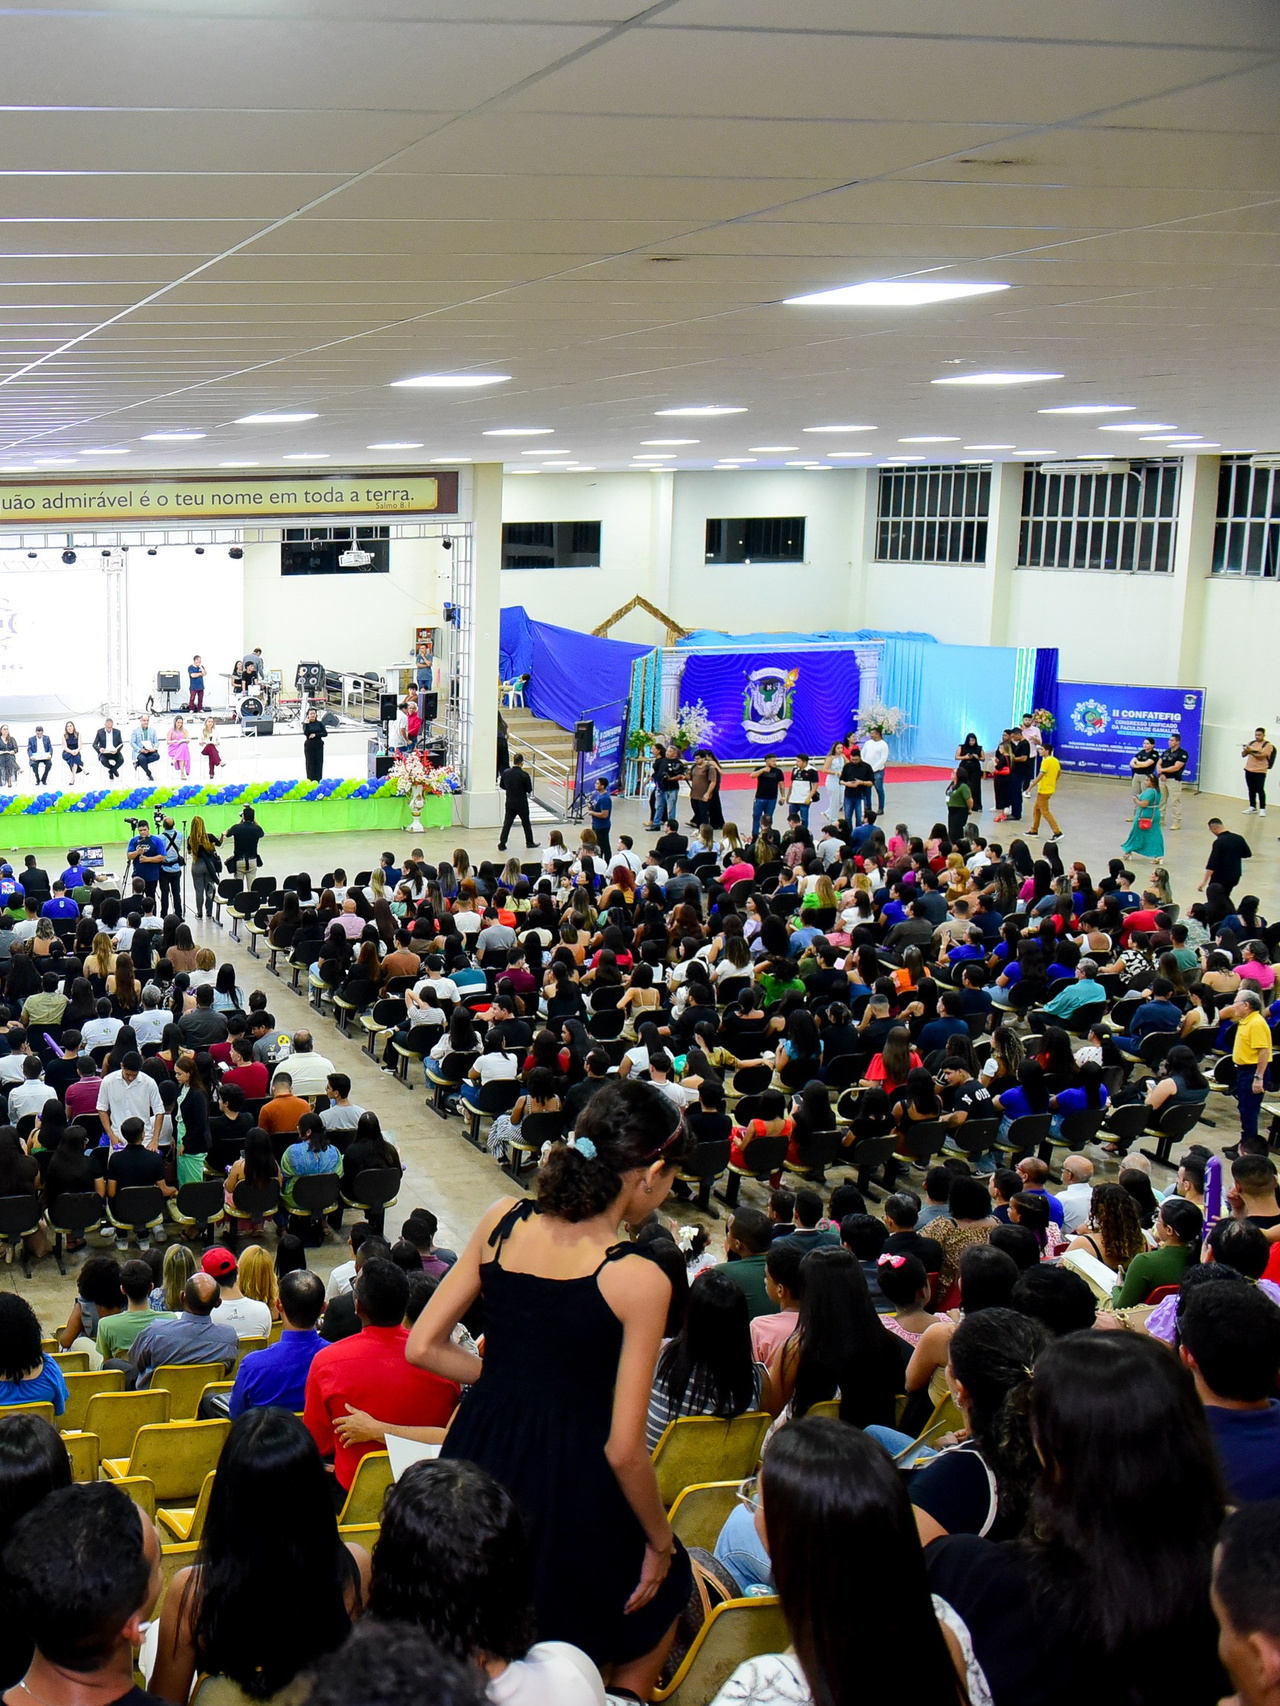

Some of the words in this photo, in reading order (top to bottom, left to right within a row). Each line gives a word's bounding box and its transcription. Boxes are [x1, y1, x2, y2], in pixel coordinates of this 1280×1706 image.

[41, 490, 133, 511] admirável
[139, 488, 151, 507] é
[157, 494, 169, 507] o
[175, 492, 205, 507] teu
[211, 491, 263, 506] nome
[269, 490, 297, 504] em
[303, 486, 345, 504] toda
[350, 489, 360, 503] a
[365, 487, 415, 503] terra.
[375, 502, 398, 510] Salmo
[1113, 709, 1120, 717] II
[1121, 710, 1182, 721] CONFATEFIG
